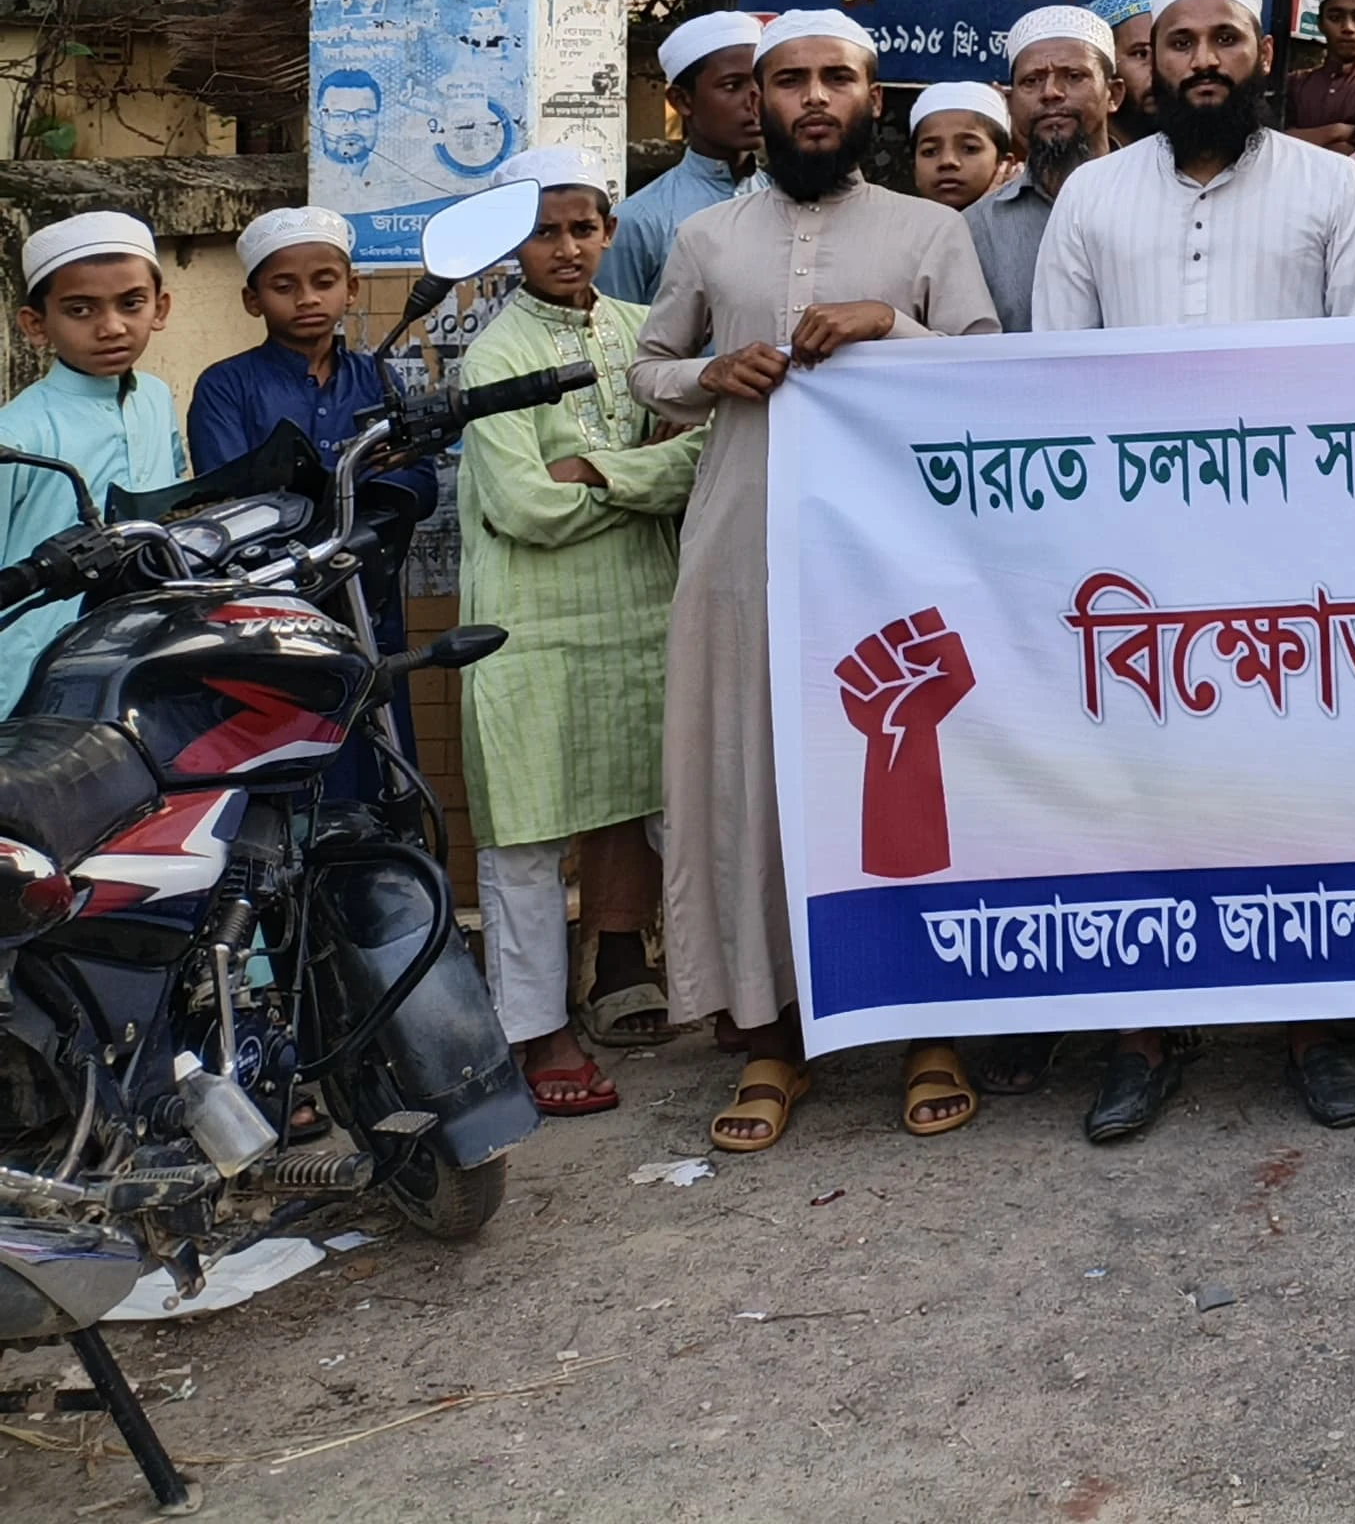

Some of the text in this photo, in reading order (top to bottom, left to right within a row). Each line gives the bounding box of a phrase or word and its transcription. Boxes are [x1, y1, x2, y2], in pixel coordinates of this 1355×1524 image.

[909, 430, 1094, 517] ভারতে
[1108, 416, 1297, 506] চলমান
[921, 894, 1198, 978] আয়োজনেঃ
